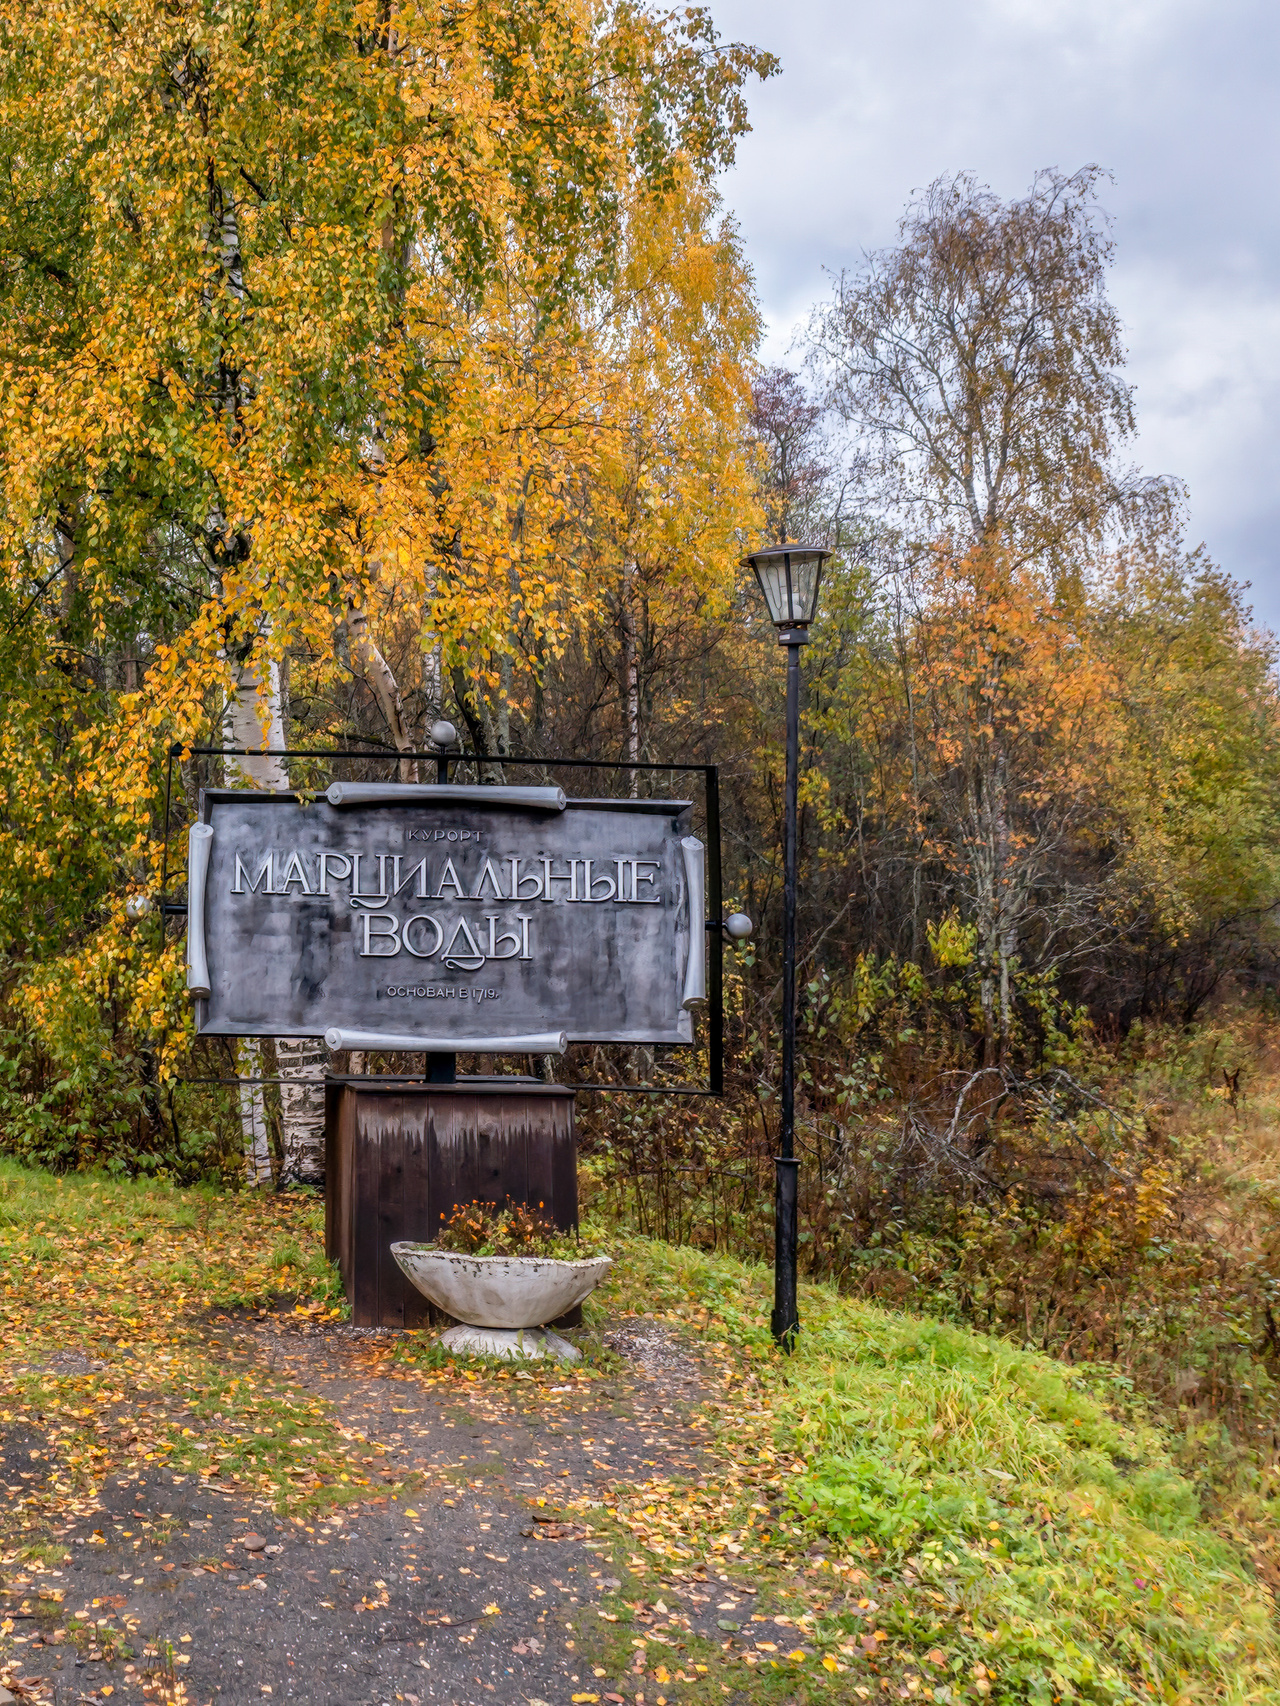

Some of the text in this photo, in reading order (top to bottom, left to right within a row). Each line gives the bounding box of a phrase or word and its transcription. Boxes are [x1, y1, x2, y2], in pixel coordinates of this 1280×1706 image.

[408, 829, 484, 843] КУРОРТ
[231, 852, 662, 909] МАРЦИАЛЬНЫЕ
[360, 913, 533, 970] ВОДЫ
[387, 986, 455, 998] ОСНОВАН
[459, 987, 469, 999] В
